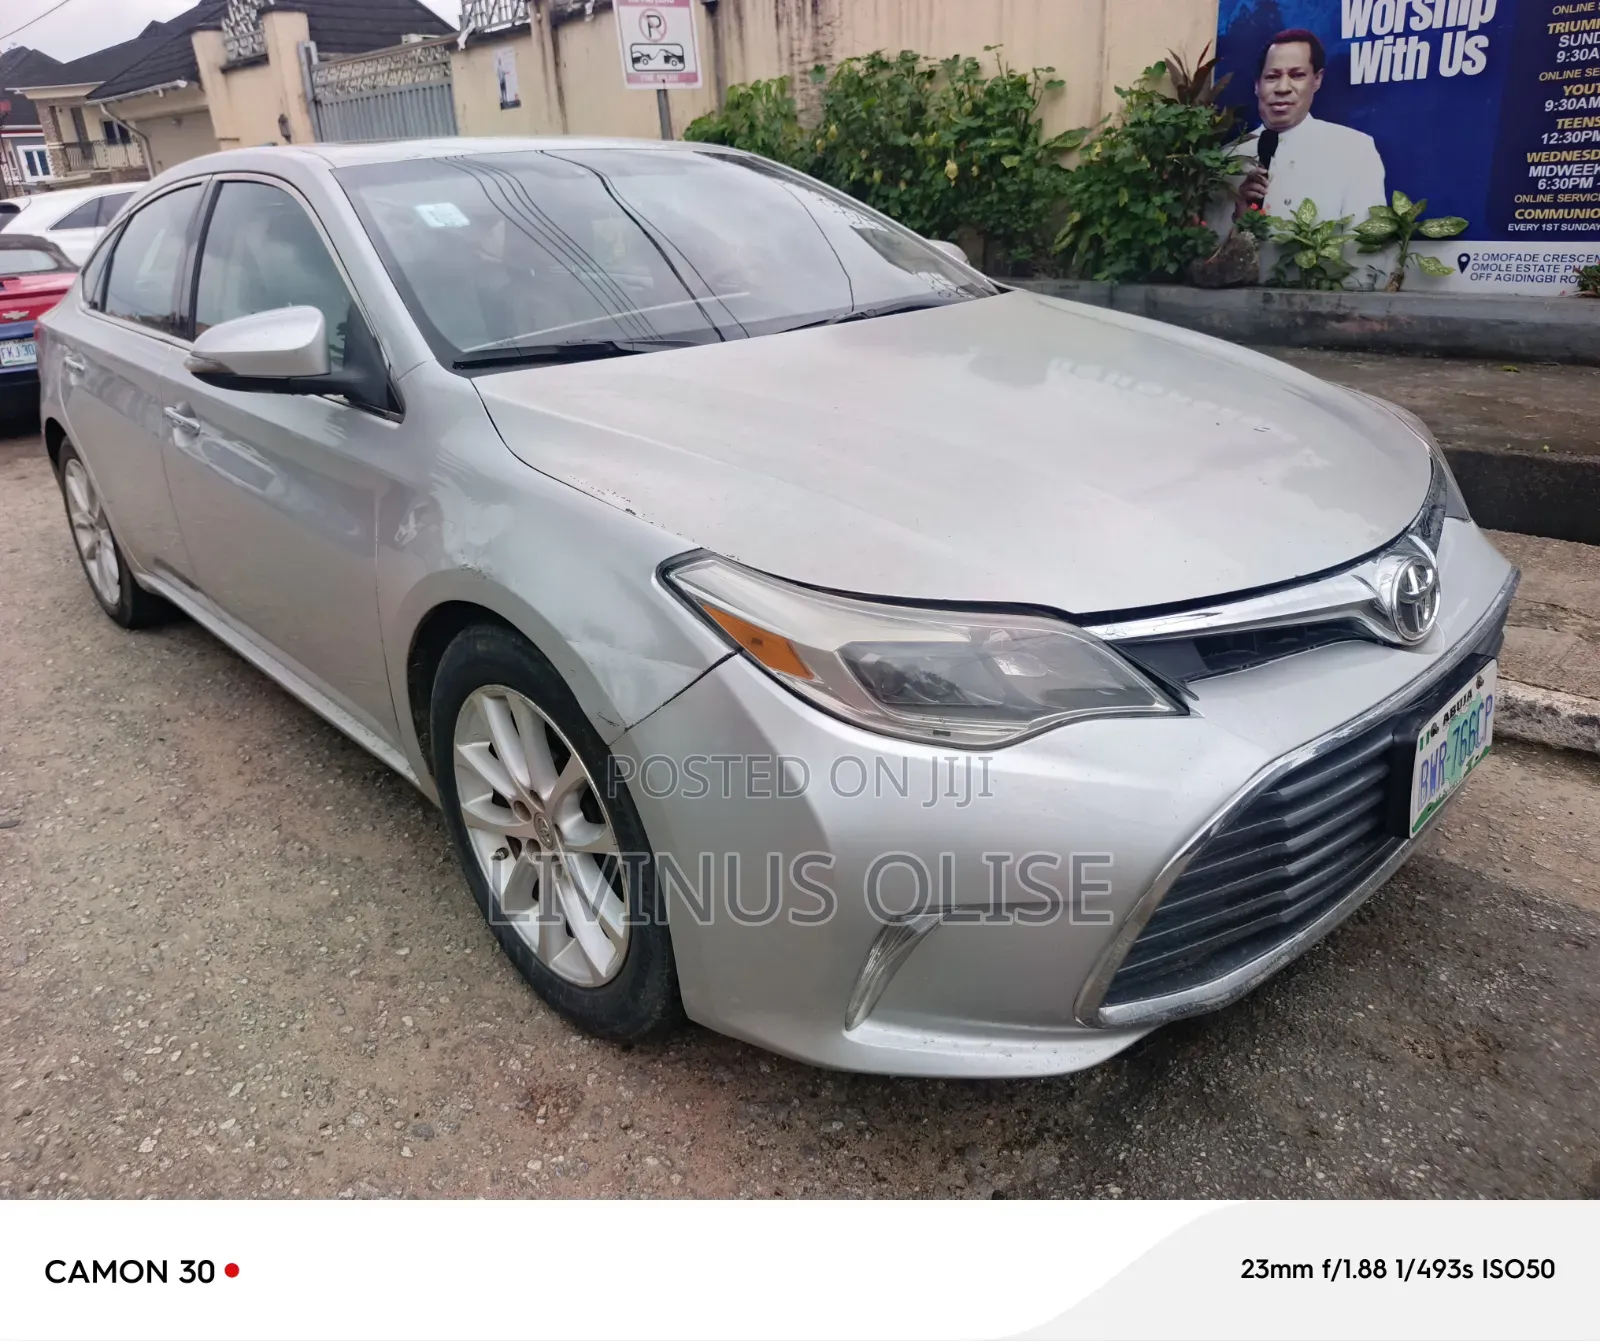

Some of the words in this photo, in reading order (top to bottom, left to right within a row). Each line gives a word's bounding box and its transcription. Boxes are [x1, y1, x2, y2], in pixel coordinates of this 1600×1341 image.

[1552, 2, 1595, 15] ONLINE
[1341, 0, 1497, 39] Worship
[1350, 36, 1430, 85] With
[1439, 31, 1489, 77] Us
[1538, 69, 1582, 81] ONLINE
[1544, 96, 1600, 112] 9:30AM
[1556, 116, 1600, 130] TEENS
[1538, 177, 1594, 190] 6:30PM
[1514, 194, 1554, 203] ONLINE
[1557, 193, 1600, 203] SERVIC
[1515, 208, 1600, 220] COMMUNIO
[1508, 223, 1540, 231] EVERY
[1541, 223, 1559, 231] 1ST
[1560, 223, 1600, 231] SUNDAY
[1473, 252, 1479, 261] 2
[1482, 253, 1540, 262] OMOFADE
[1471, 263, 1513, 272] OMOLE
[1516, 264, 1560, 273] ESTATE
[1470, 272, 1492, 281] OFF
[1495, 274, 1557, 284] AGIDINGBI
[1443, 689, 1473, 725] ABUJA
